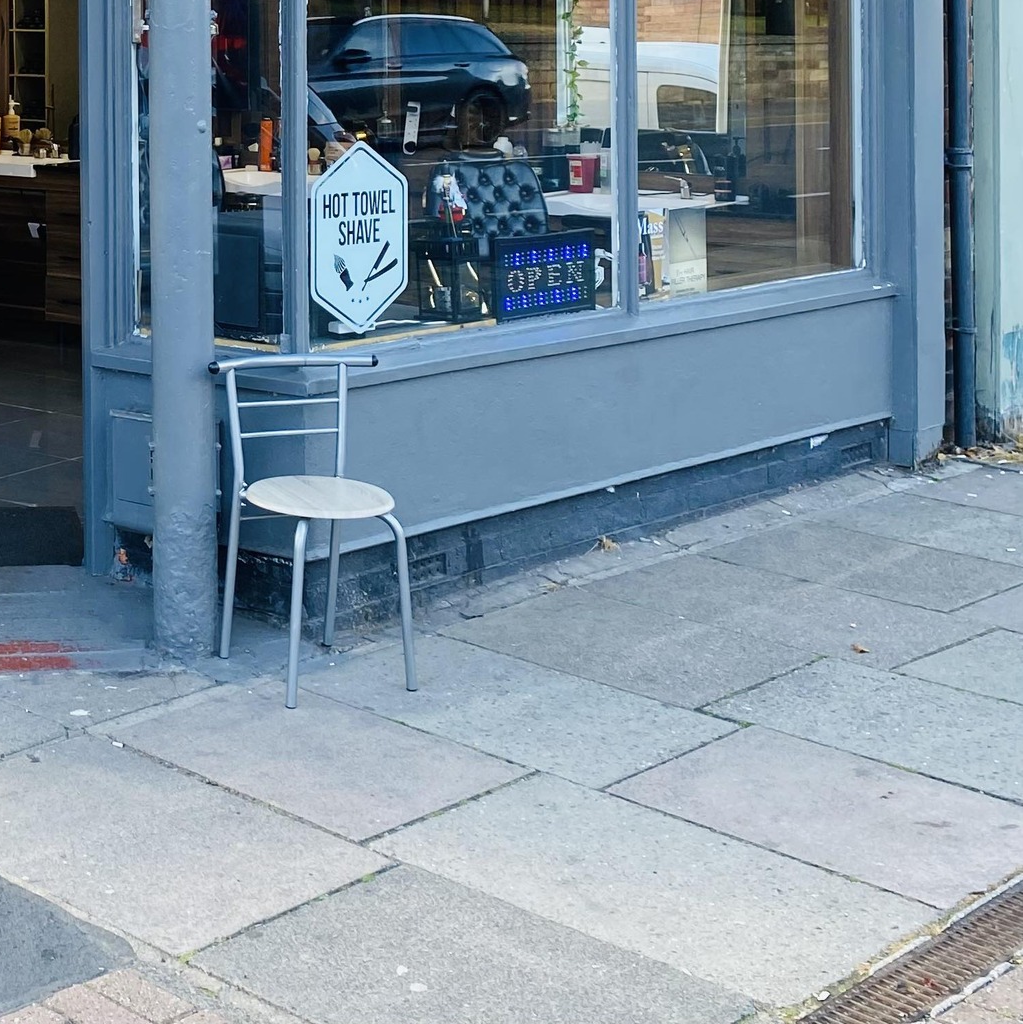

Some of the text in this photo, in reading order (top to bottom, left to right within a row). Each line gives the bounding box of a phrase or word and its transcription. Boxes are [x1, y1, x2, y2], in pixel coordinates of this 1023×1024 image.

[323, 189, 395, 219] HOT TOWEL
[338, 218, 380, 246] SHAVE
[507, 261, 585, 292] OPEN
